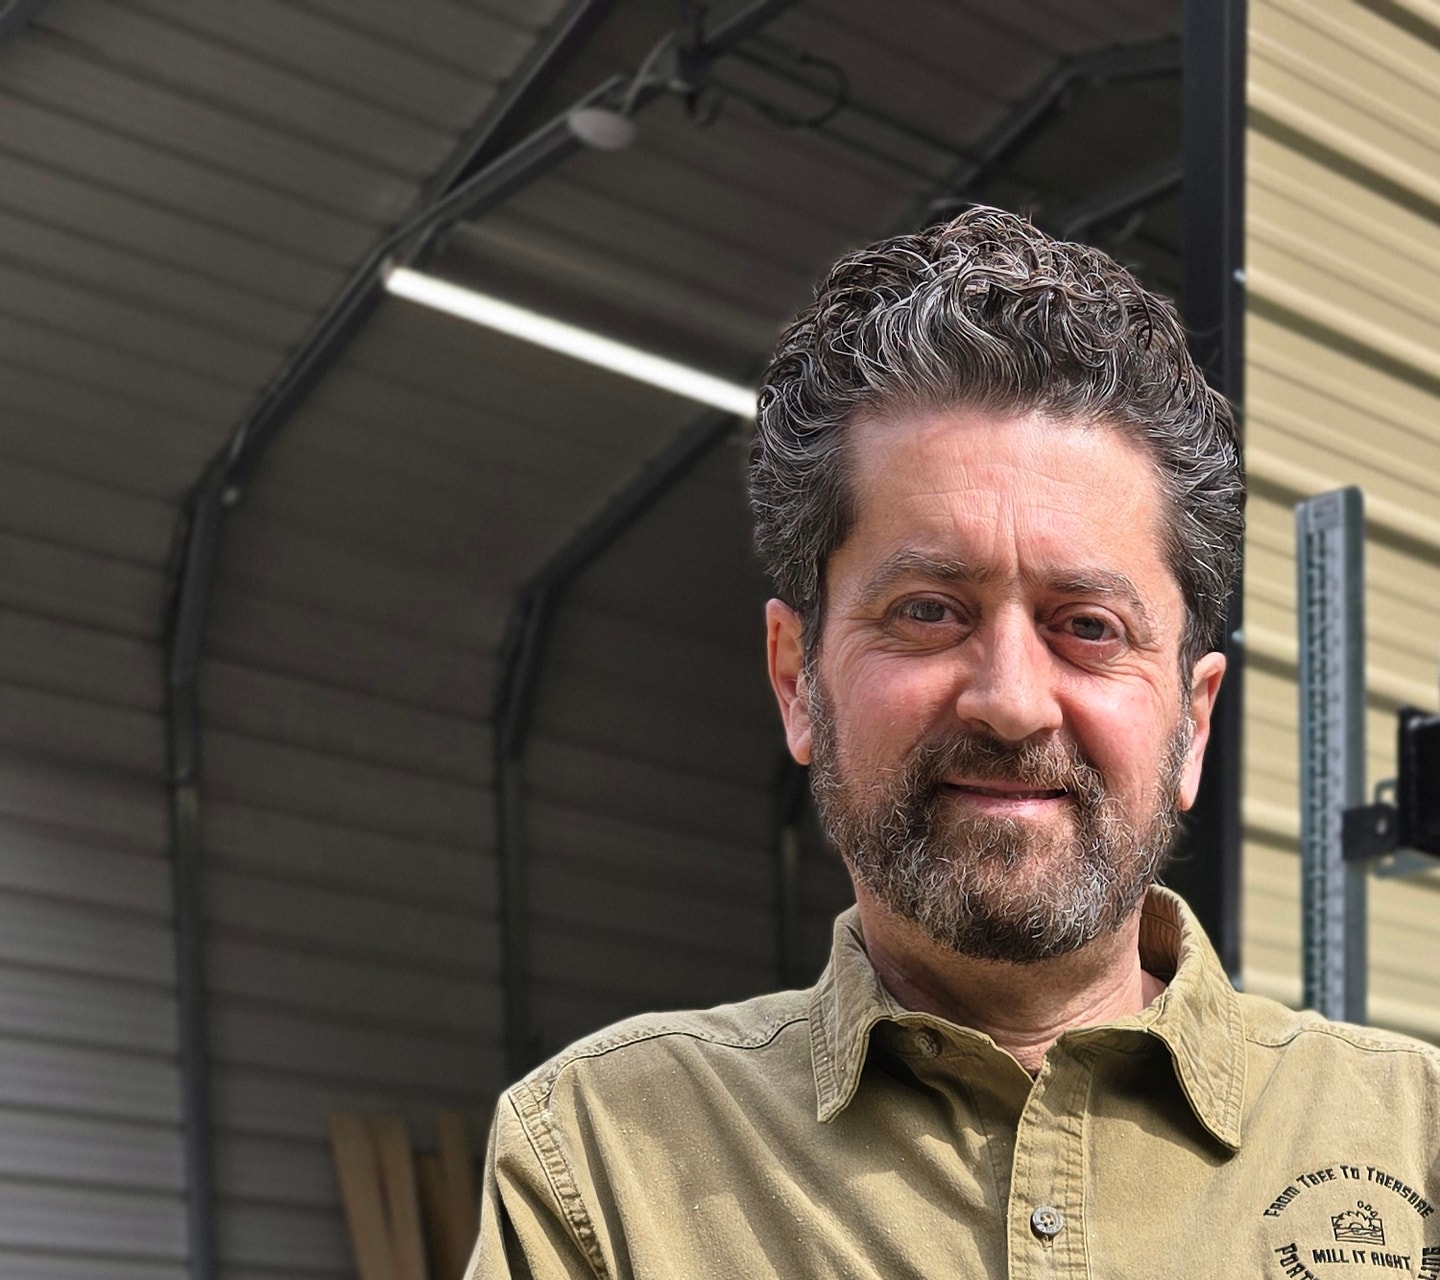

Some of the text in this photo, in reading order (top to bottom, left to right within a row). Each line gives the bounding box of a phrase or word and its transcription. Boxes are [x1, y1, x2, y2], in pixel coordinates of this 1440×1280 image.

[1340, 1164, 1360, 1180] TO
[1366, 1166, 1435, 1219] TREASURE
[1312, 1248, 1411, 1271] MILL IT RIGHT
